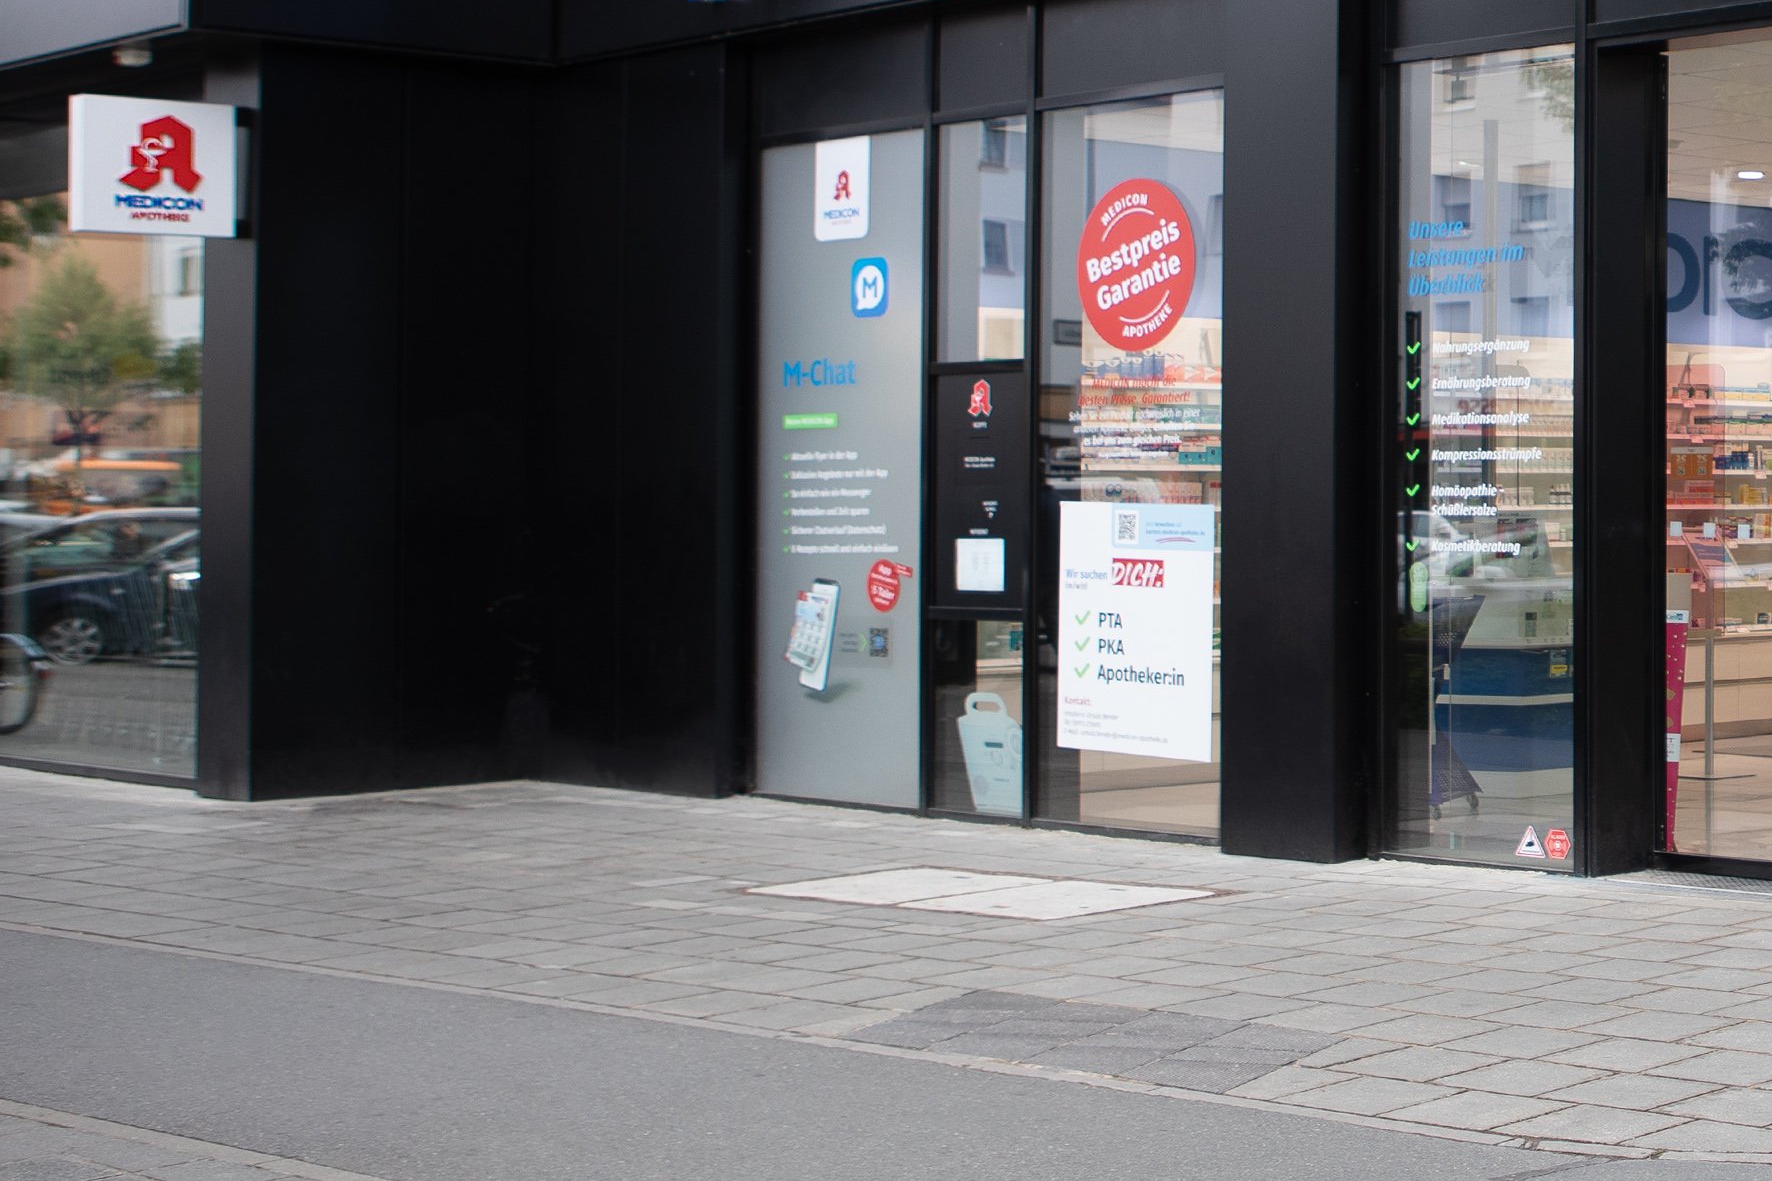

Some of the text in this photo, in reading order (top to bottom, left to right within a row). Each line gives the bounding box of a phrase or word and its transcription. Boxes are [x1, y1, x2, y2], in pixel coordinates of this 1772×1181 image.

[114, 194, 204, 210] MEDICON
[1101, 194, 1148, 226] MEDICON
[824, 207, 860, 220] MEDICON
[1408, 221, 1465, 240] Unsere
[1086, 218, 1181, 283] Bestpreis
[1408, 242, 1525, 269] Leistungen im
[862, 276, 877, 298] M
[1096, 252, 1182, 311] Garantie
[1408, 273, 1486, 297] Überblick
[1122, 303, 1173, 337] APOTHEKE
[1432, 339, 1530, 356] Nahrungsergänzung
[783, 359, 856, 387] M-Chat
[1432, 375, 1531, 390] Ernährungsberatung
[1142, 391, 1191, 403] Garantiert!
[1431, 411, 1530, 427] Medikationsanalyse
[1431, 447, 1543, 463] Kompressionsstrümpfe
[1431, 483, 1497, 500] Homöopathie
[1431, 503, 1497, 517] Schüßlersalze
[1431, 539, 1521, 555] Kosmetikberatung
[1066, 561, 1165, 588] Wir suchen DICH:
[1098, 612, 1123, 629] PTA
[1098, 638, 1125, 656] PKA
[1097, 664, 1185, 686] Apotheker:in
